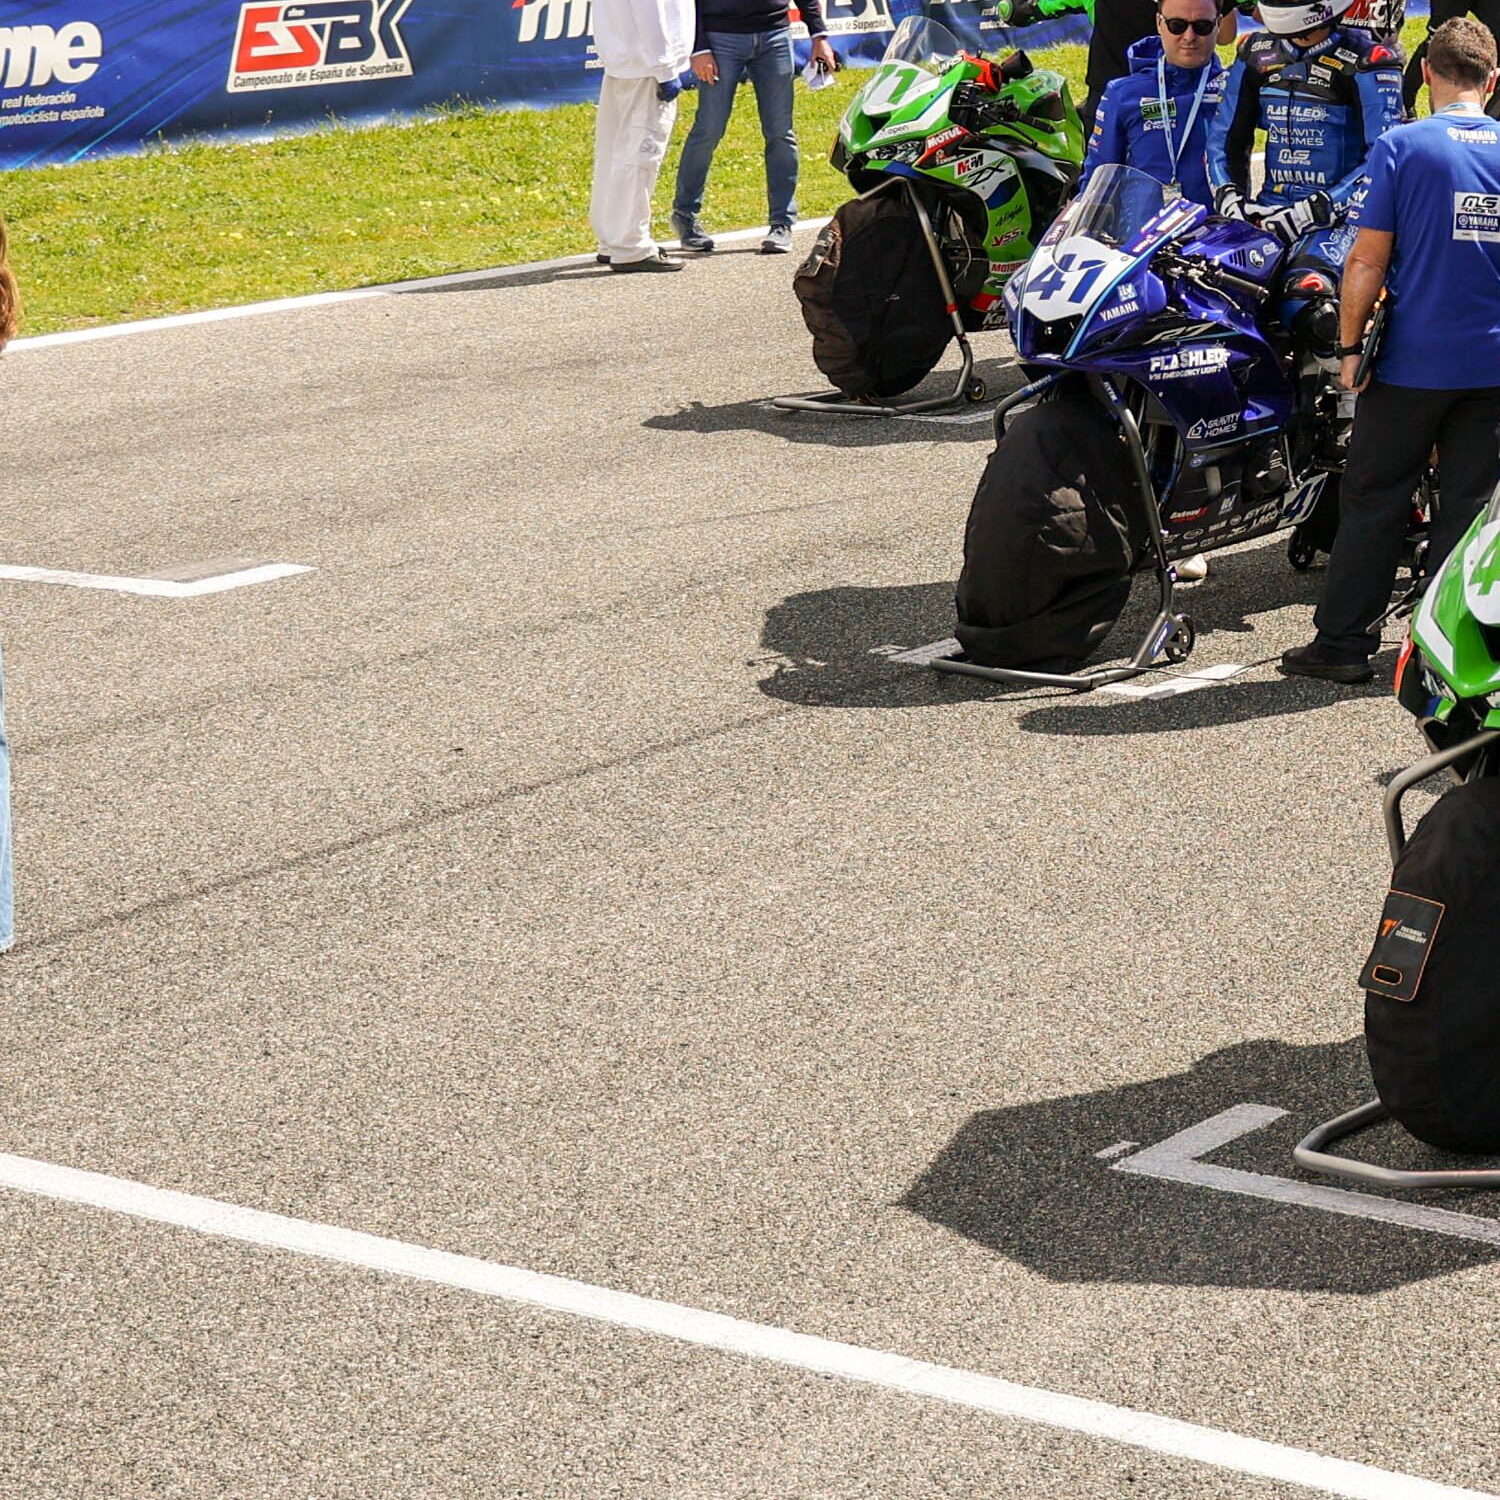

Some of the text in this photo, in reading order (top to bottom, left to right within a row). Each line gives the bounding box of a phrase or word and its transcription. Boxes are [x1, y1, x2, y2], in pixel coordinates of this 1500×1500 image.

[0, 21, 103, 88] me
[234, 61, 405, 89] Campeonato de España de Superbike
[2, 91, 77, 109] real federación
[60, 105, 105, 122] española
[926, 127, 962, 149] MOTUL
[1460, 128, 1498, 142] YAMAHA
[967, 159, 1005, 188] ZX
[1270, 168, 1327, 184] YAMAHA
[1461, 195, 1499, 209] MS
[1468, 215, 1499, 228] YAMAHA
[992, 227, 1021, 248] YSS
[1024, 253, 1109, 304] 41
[1099, 300, 1140, 322] YAMAHA
[1150, 347, 1229, 373] FLASHLED
[1207, 411, 1241, 429] GRAVITY
[1204, 422, 1238, 439] HOMES
